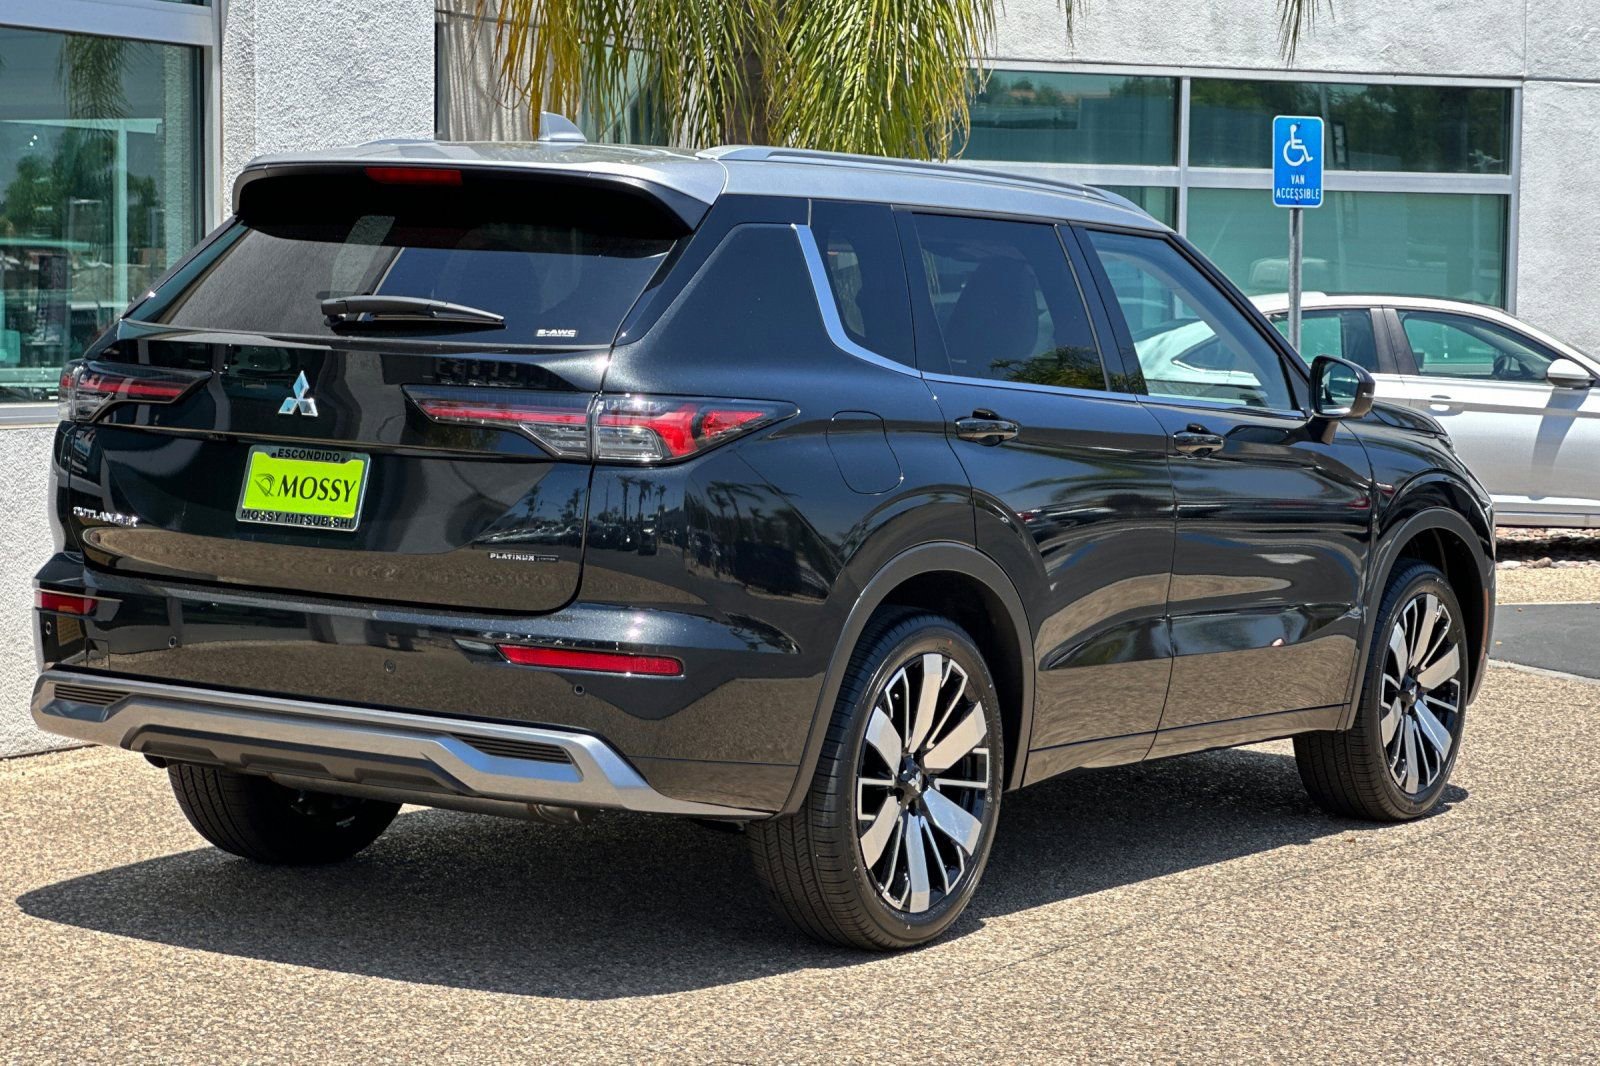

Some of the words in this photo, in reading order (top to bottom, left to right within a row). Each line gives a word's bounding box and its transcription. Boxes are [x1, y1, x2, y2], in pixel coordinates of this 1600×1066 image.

[1290, 174, 1305, 185] VAN
[1276, 187, 1320, 200] ACCESSIBLE
[278, 448, 340, 462] ESCONDIDO
[277, 474, 357, 503] MOSSY
[240, 509, 281, 524] MOSSY
[490, 552, 535, 562] PLATINUM
